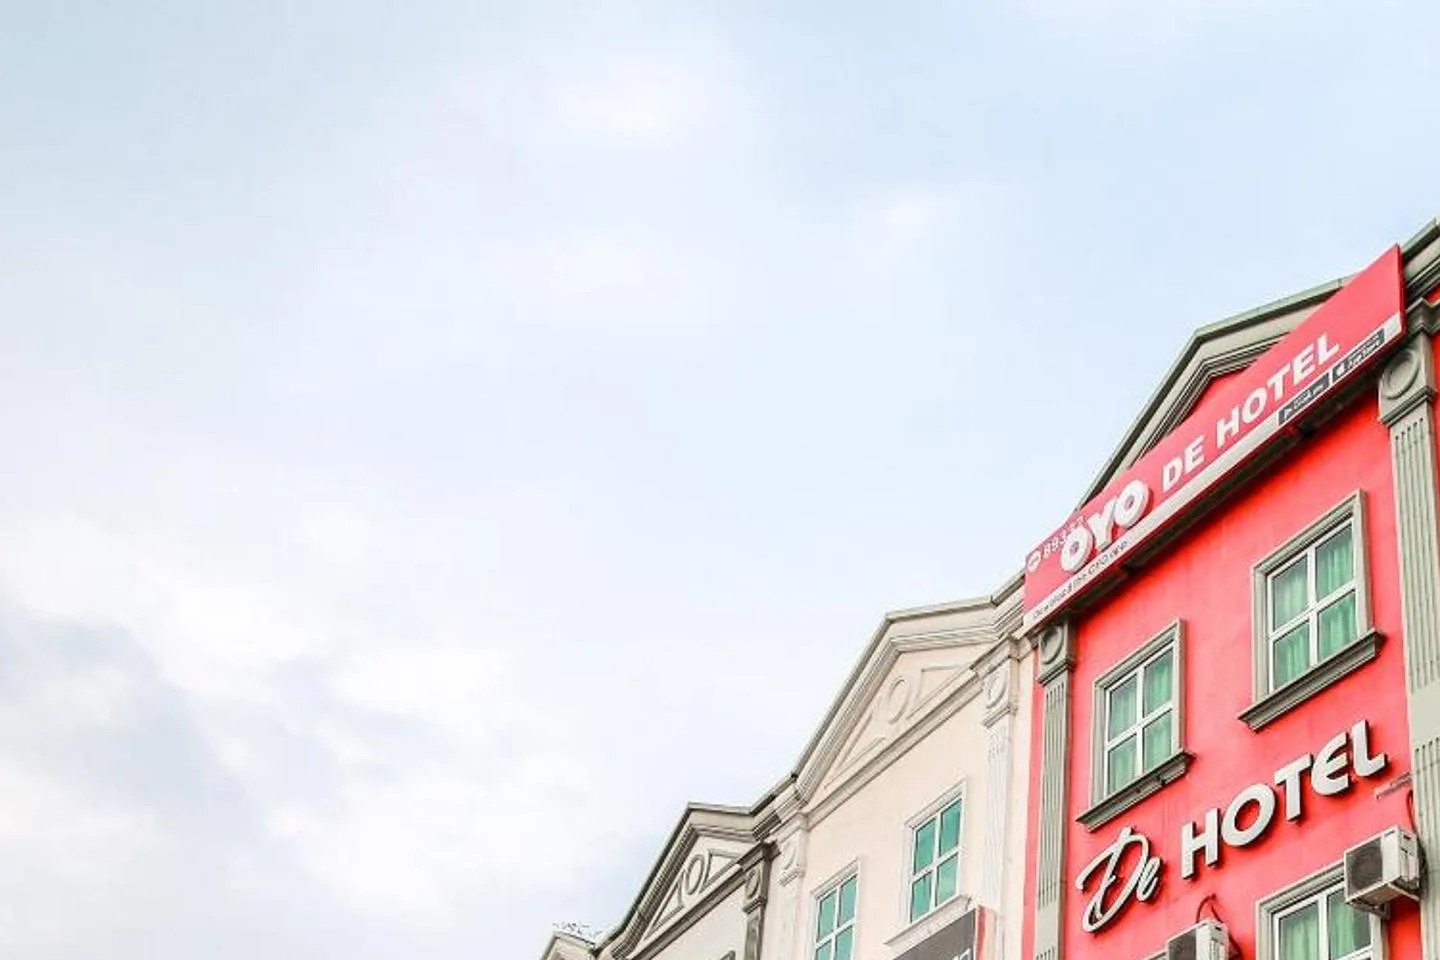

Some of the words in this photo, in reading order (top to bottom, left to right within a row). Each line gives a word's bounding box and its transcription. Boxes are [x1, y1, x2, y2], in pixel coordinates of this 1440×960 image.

[1060, 479, 1150, 573] OYO
[1161, 435, 1206, 493] DE
[1216, 332, 1341, 449] HOTEL
[1075, 826, 1162, 933] De
[1181, 719, 1387, 879] HOTEL
